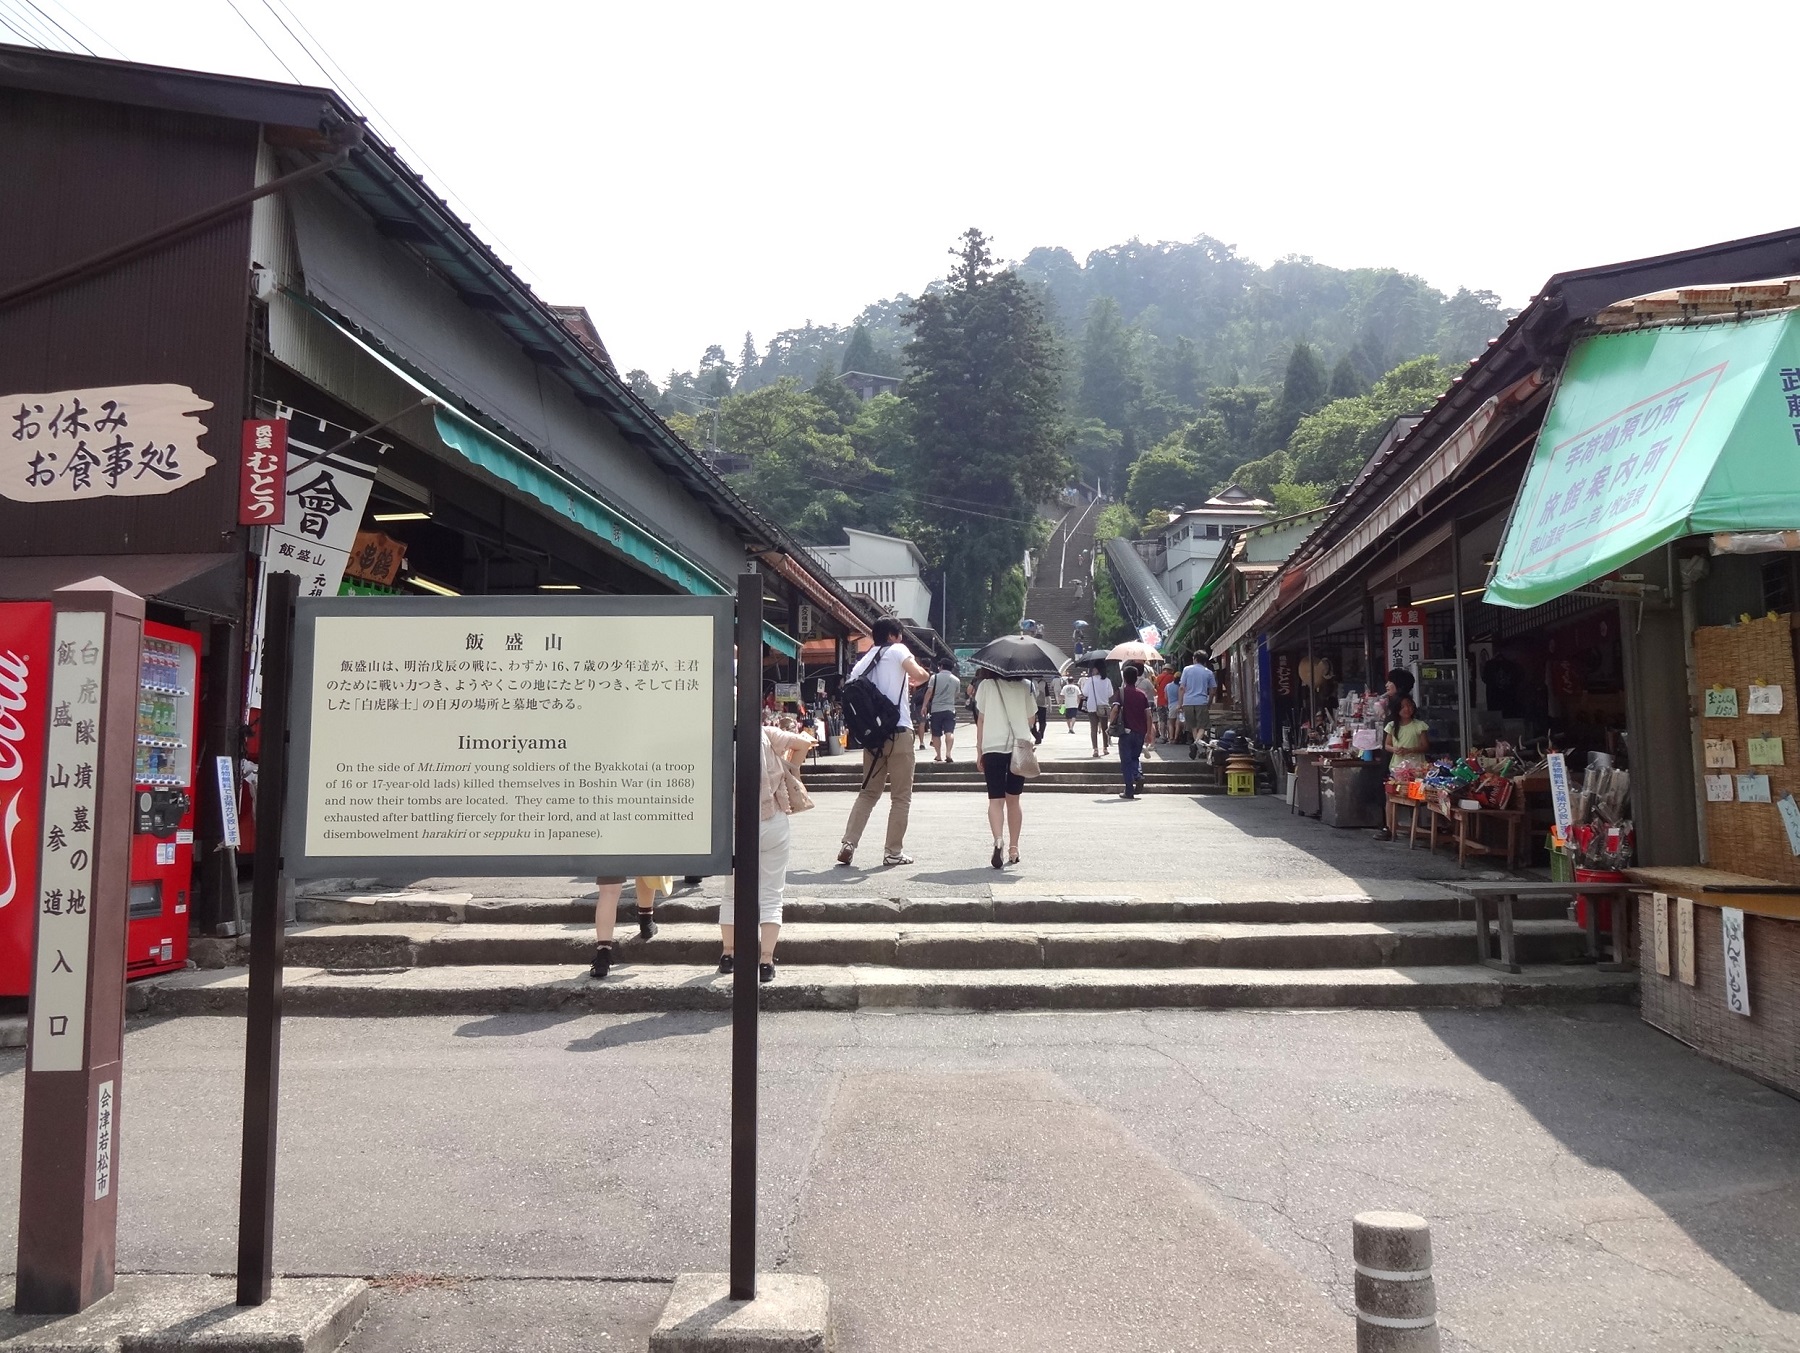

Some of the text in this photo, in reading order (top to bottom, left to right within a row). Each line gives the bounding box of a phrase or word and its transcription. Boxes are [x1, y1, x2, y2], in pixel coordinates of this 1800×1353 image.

[11, 397, 128, 441] お休み
[24, 434, 182, 492] お食事処
[246, 451, 279, 519] むとう
[1536, 435, 1673, 528] 旅館案内所
[278, 542, 326, 567] 飯盛山
[1391, 610, 1419, 624] 旅館
[465, 632, 563, 651] 飯盛山
[457, 734, 568, 754] Iimoriyama
[66, 640, 99, 915] 白虎隊墳墓の地
[336, 761, 695, 776] On the side of Mt.Iimori young soldiers of the Byakkotai (a troop
[325, 777, 695, 792] of 16 or 17-year-old lads) killed themselves in Boshin War (in 1868)
[324, 794, 695, 808] and now their tombs are located. They came to this mountainside
[323, 811, 694, 825] exhausted after battling fiercely for their lord, and at last committed
[43, 640, 78, 1037] 飯盛山参道入口
[322, 828, 603, 841] disembowelment harakiri or seppuku in Japanese).
[97, 1088, 112, 1192] 会津若松市
